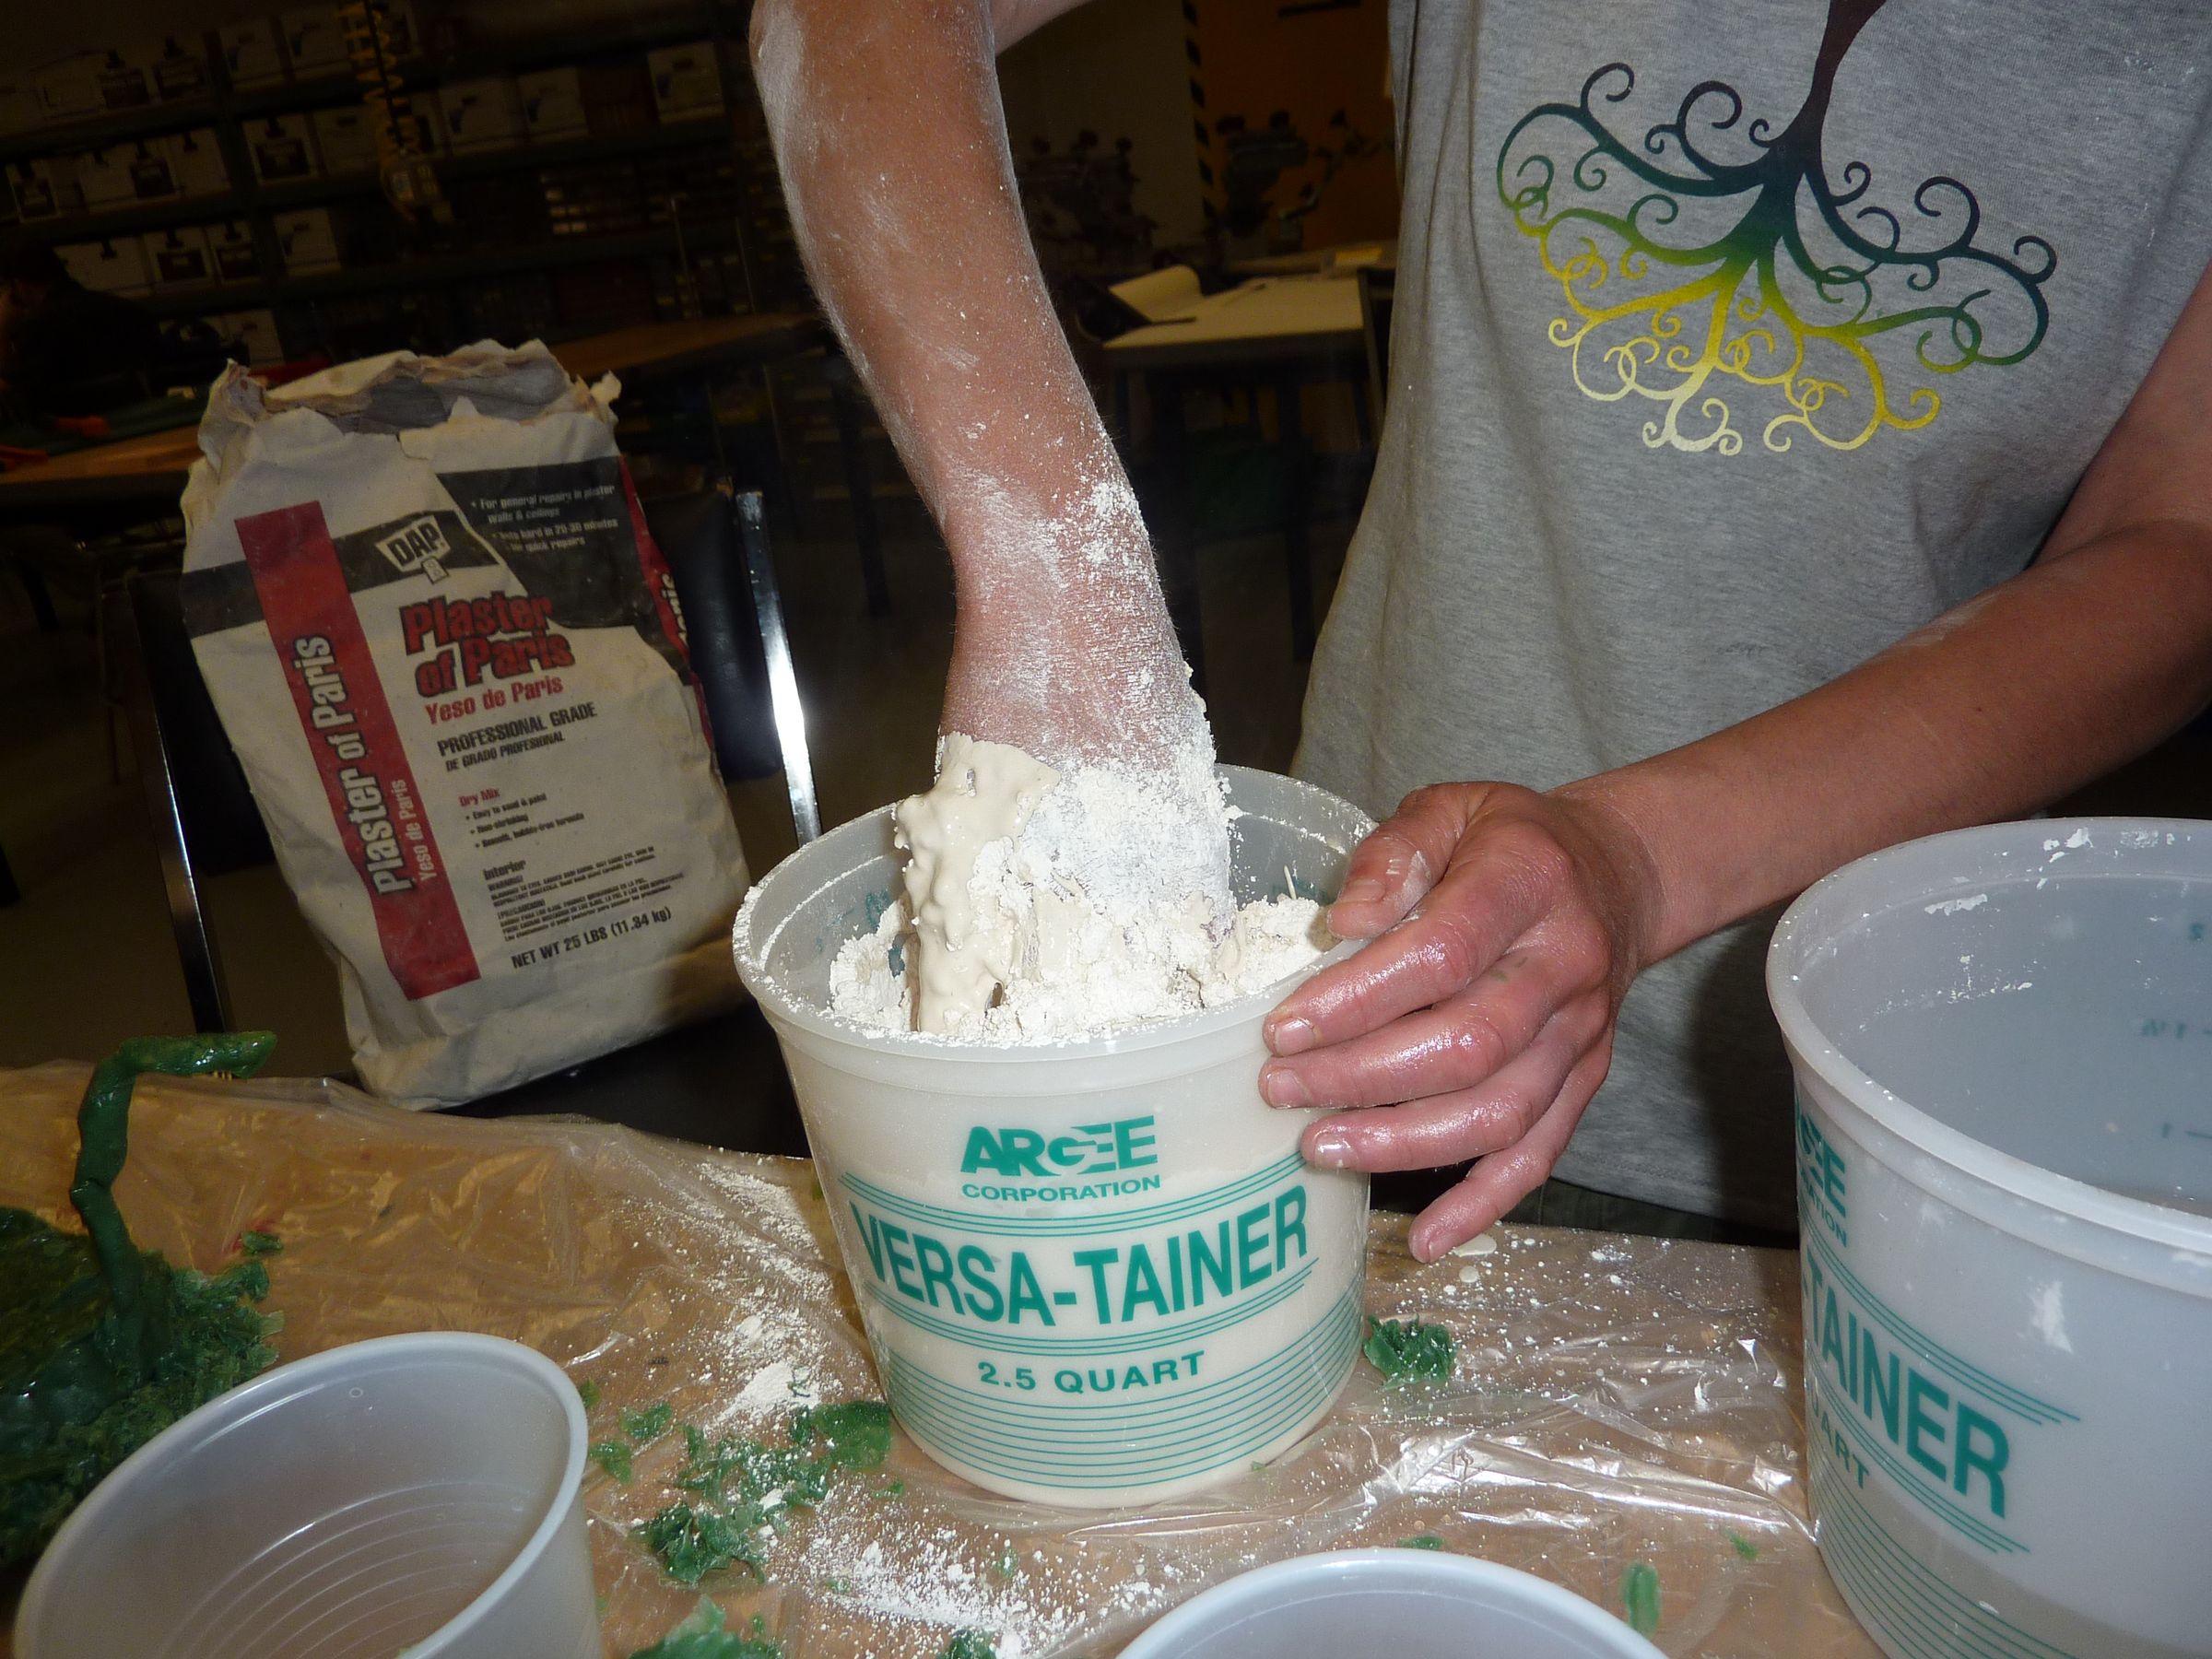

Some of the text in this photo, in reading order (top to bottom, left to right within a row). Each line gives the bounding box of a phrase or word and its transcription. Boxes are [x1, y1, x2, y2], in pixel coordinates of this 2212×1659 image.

[387, 523, 441, 566] DAP
[399, 591, 553, 656] Plaster
[415, 629, 575, 698] of Paris
[425, 676, 563, 724] Yeso de Paris
[437, 701, 597, 756] PROFESSIONAL GRADE
[293, 633, 415, 896] Plaster of Paris
[446, 759, 459, 771] DE
[463, 748, 498, 768] GRADO
[392, 779, 438, 881] Yeso de Paris
[483, 860, 526, 880] Interior
[512, 949, 536, 969] NET
[539, 941, 560, 959] WT
[563, 935, 582, 951] 25
[583, 926, 608, 945] LBS
[652, 906, 672, 924] kg)
[960, 1115, 1159, 1177] ARGEE
[961, 1174, 1160, 1202] CORPORATION
[850, 1184, 1308, 1327] VERSA-TAINER
[977, 1350, 1206, 1394] 2.5 QUART
